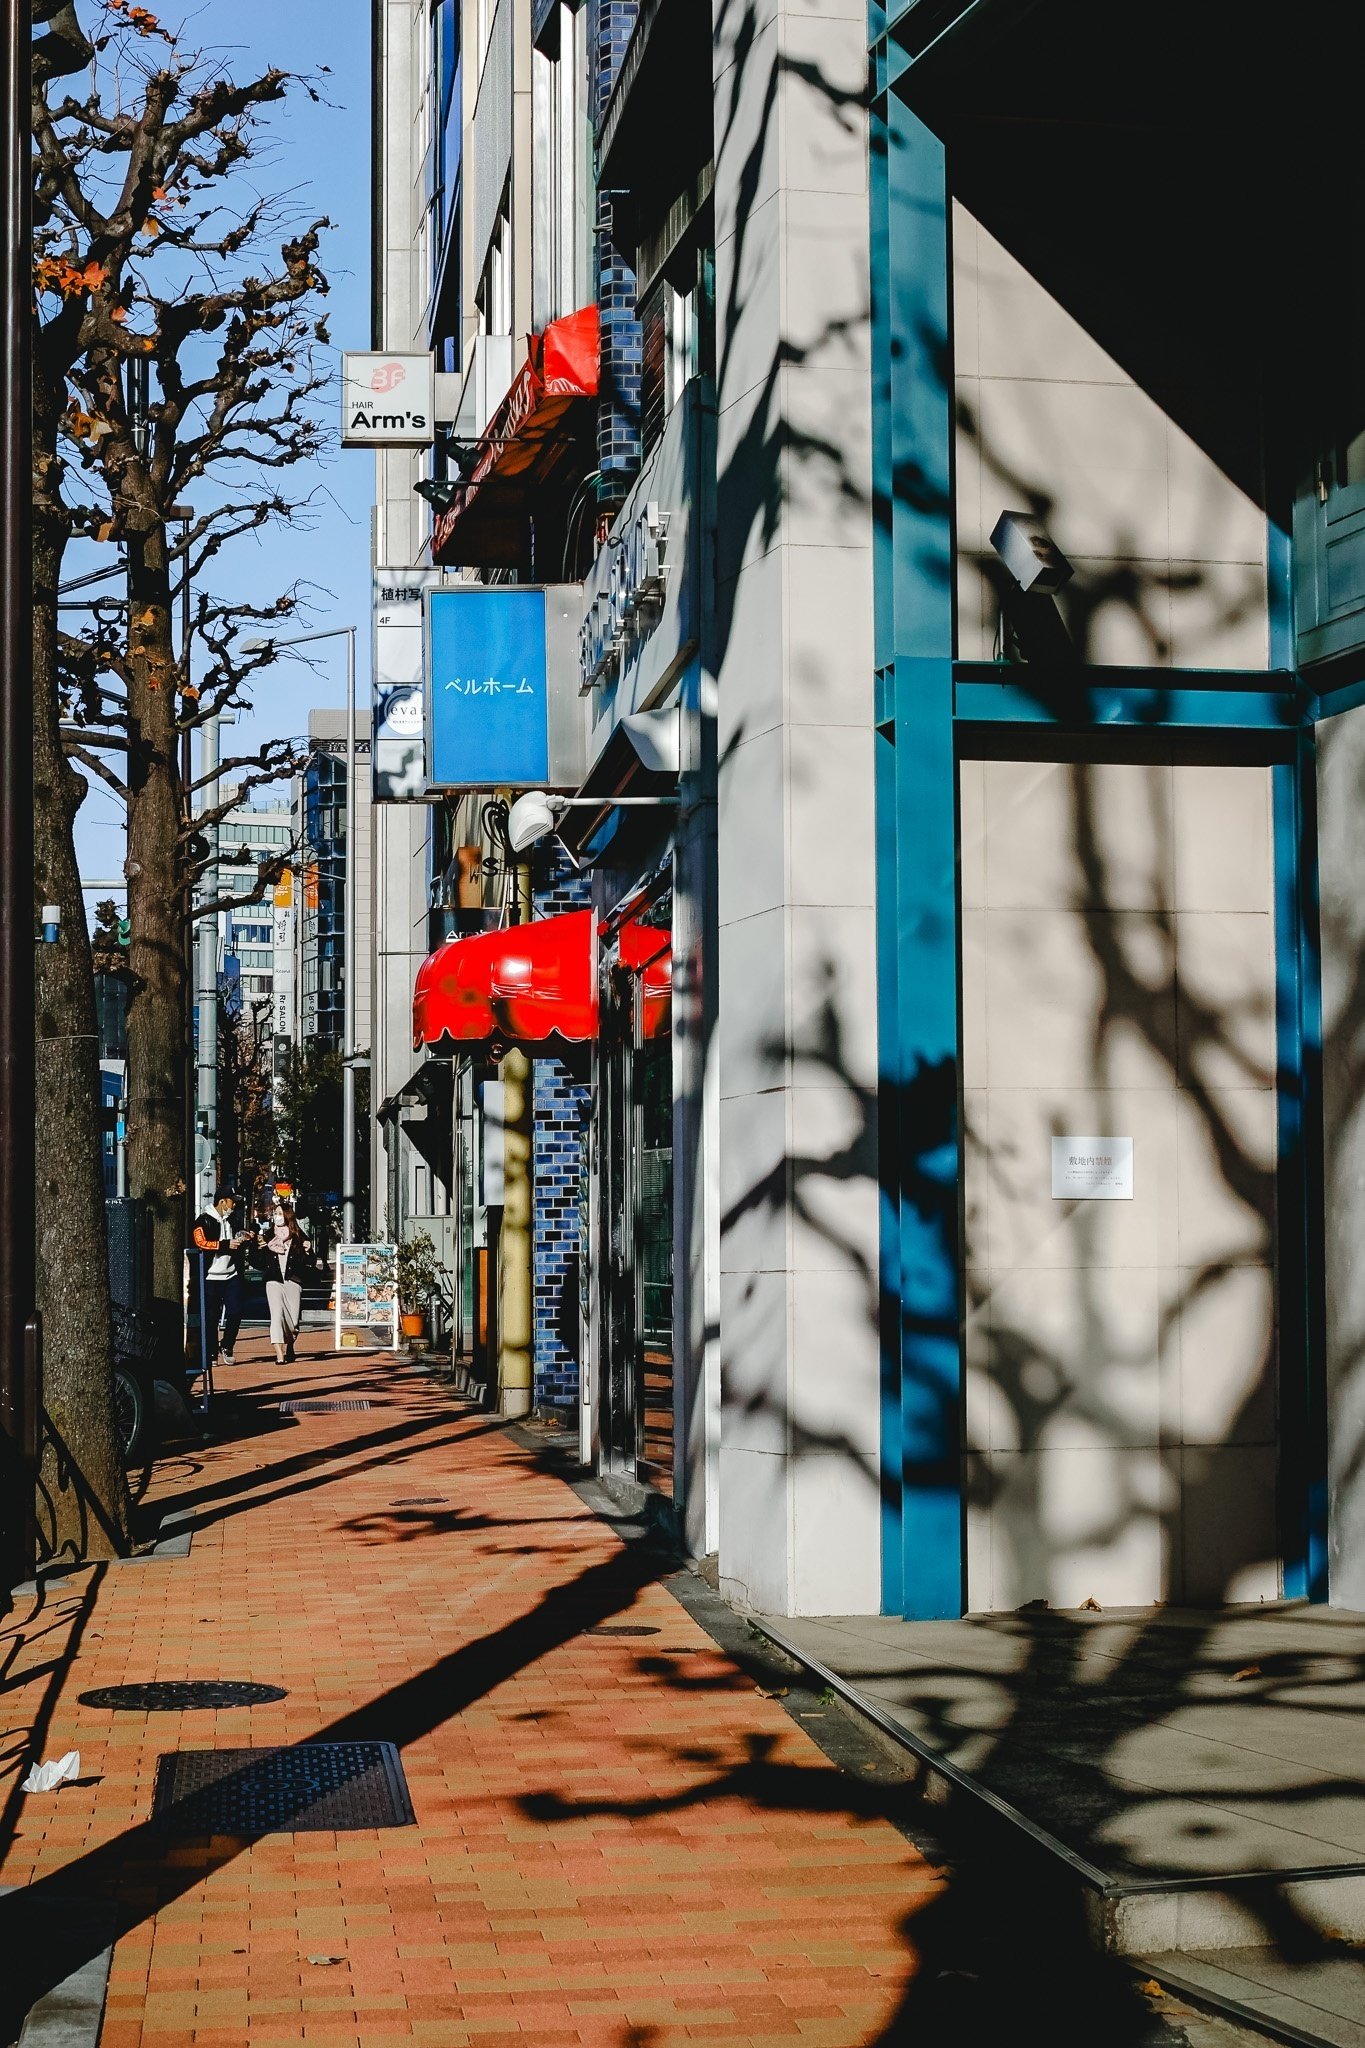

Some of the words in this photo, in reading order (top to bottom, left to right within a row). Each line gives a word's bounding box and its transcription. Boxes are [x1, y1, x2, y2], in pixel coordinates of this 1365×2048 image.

[351, 401, 374, 409] HAIR
[350, 411, 427, 429] Arm's
[379, 616, 391, 624] 4F
[444, 677, 535, 696] ベルホーム
[279, 995, 286, 1004] Rr
